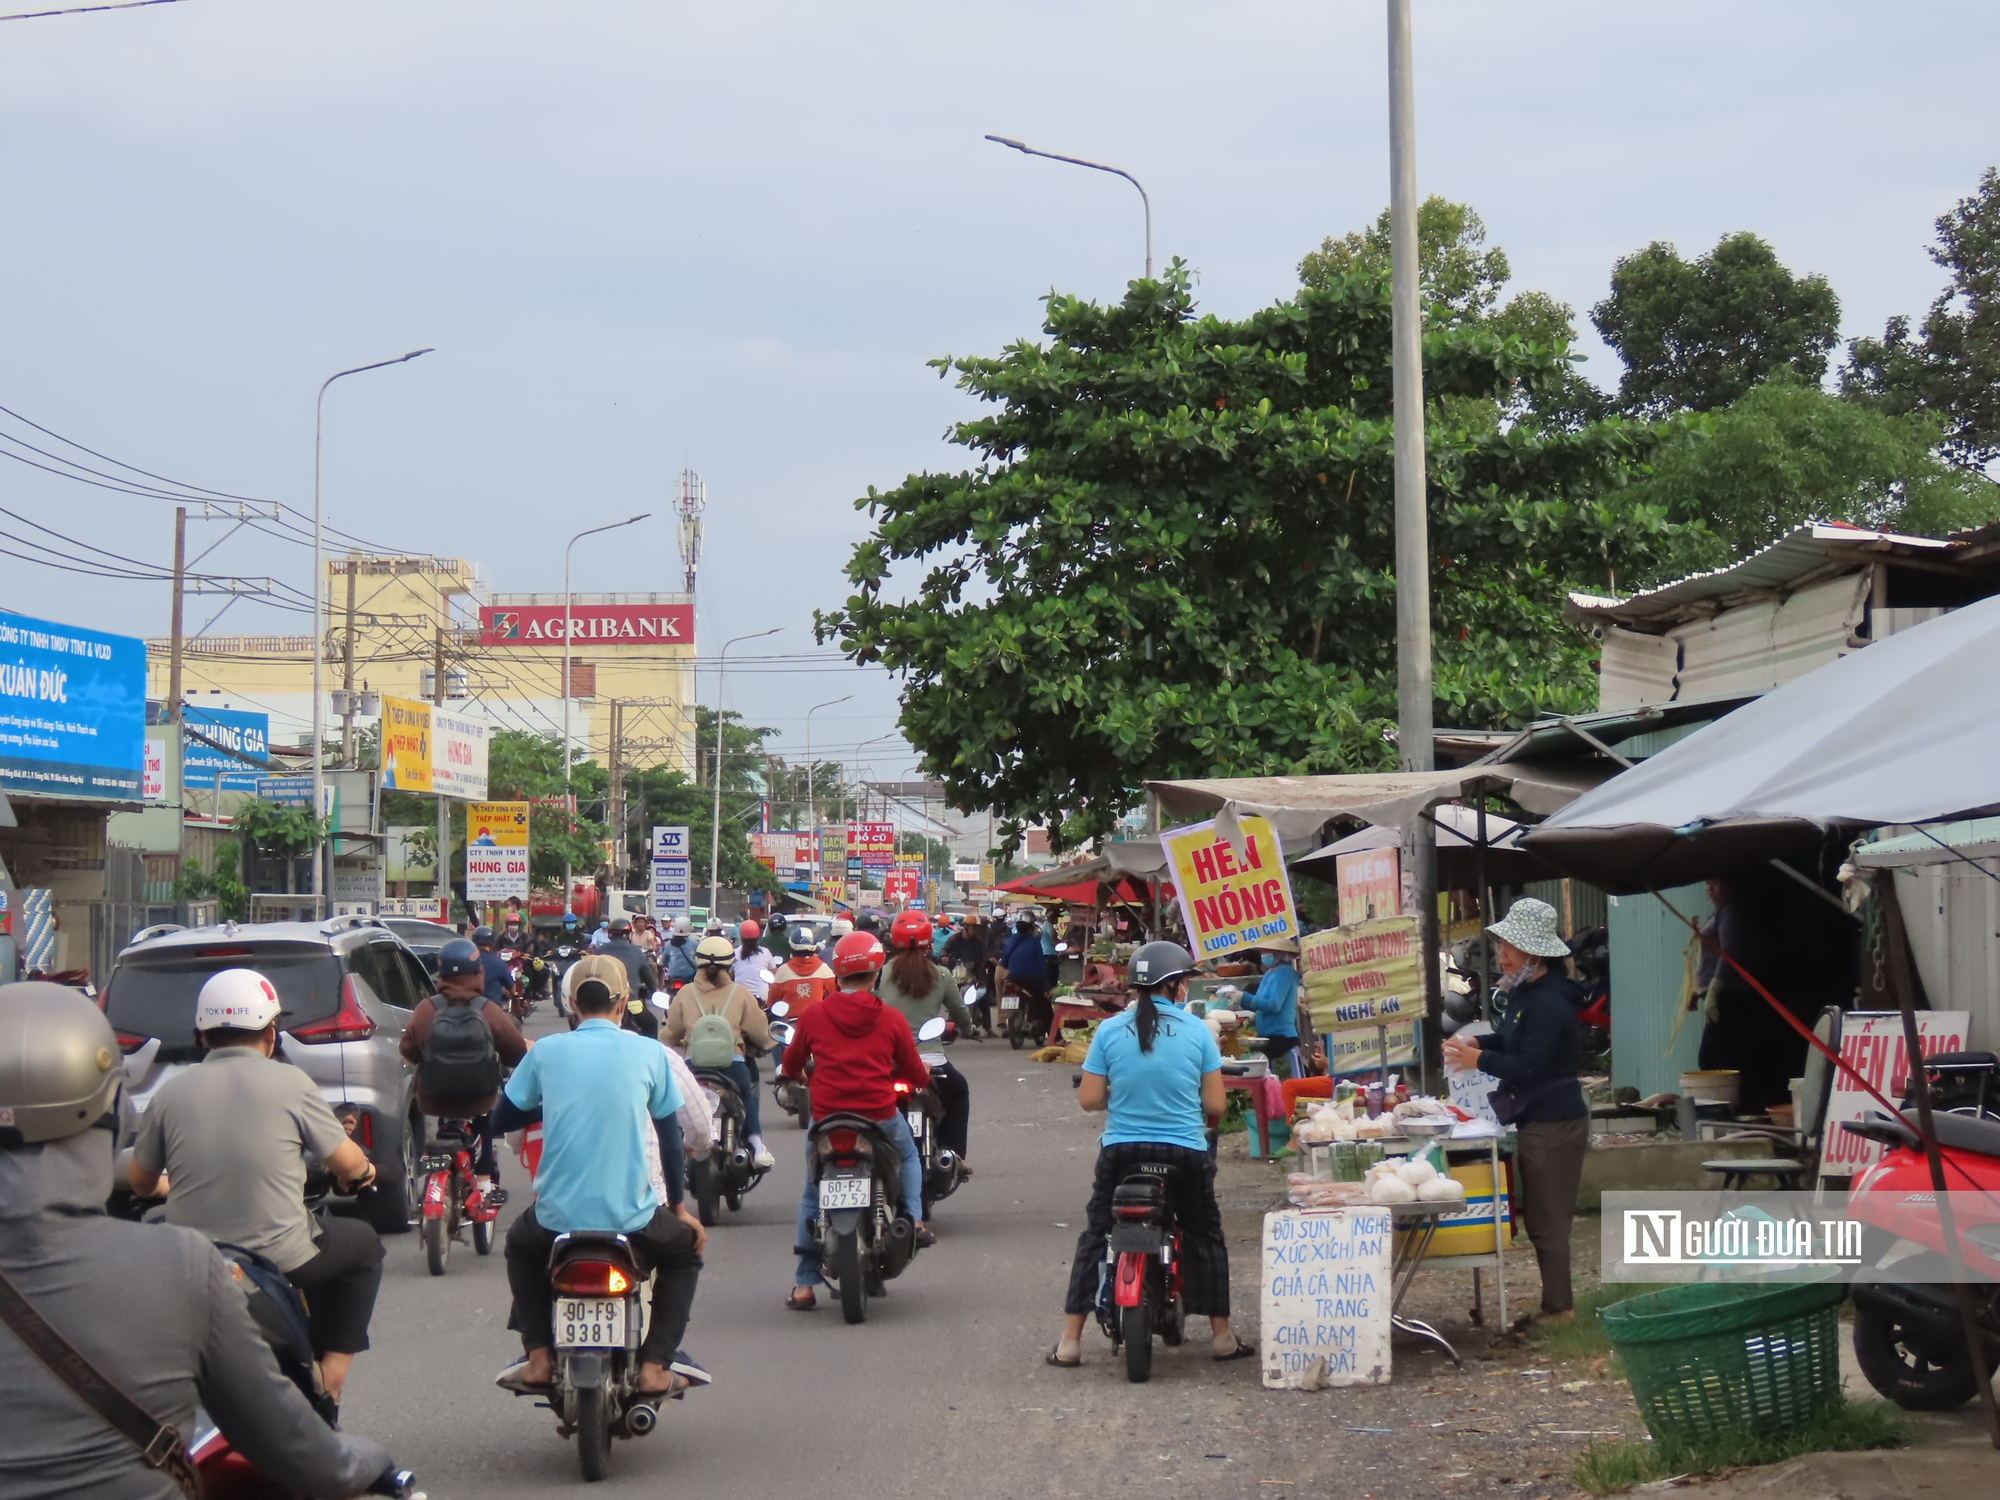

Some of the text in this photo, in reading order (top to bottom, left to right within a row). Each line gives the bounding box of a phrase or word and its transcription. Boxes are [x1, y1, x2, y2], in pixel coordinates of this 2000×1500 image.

[525, 617, 681, 639] AGRIBANK
[20, 629, 29, 645] TY
[30, 631, 49, 649] TNHH
[50, 634, 70, 653] TMDV
[70, 639, 87, 656] TTNT
[87, 642, 93, 657] &
[94, 643, 112, 660] VLXD
[40, 664, 68, 703] ĐỨC
[243, 727, 265, 753] GIA
[476, 815, 493, 823] THÉP
[875, 825, 893, 834] THỊ
[469, 859, 526, 874] HÙNG GIA
[823, 851, 844, 862] MEN
[1193, 878, 1286, 934] NÓNG
[1203, 915, 1288, 952] LUỘC TẠI CHỖ
[1380, 996, 1400, 1014] AN
[1836, 1018, 1889, 1092] HẾN
[827, 1180, 863, 1193] 60-F2
[822, 1193, 867, 1207] 027.52
[1273, 1240, 1308, 1264] XÚC
[1311, 1236, 1349, 1261] XÍCH
[1271, 1267, 1376, 1296] CHẢ CÁ NHA
[566, 1301, 615, 1321] 90-F9
[1315, 1298, 1370, 1318] TRANG
[566, 1323, 613, 1343] 9381
[1276, 1319, 1355, 1347] CHẢ RAM
